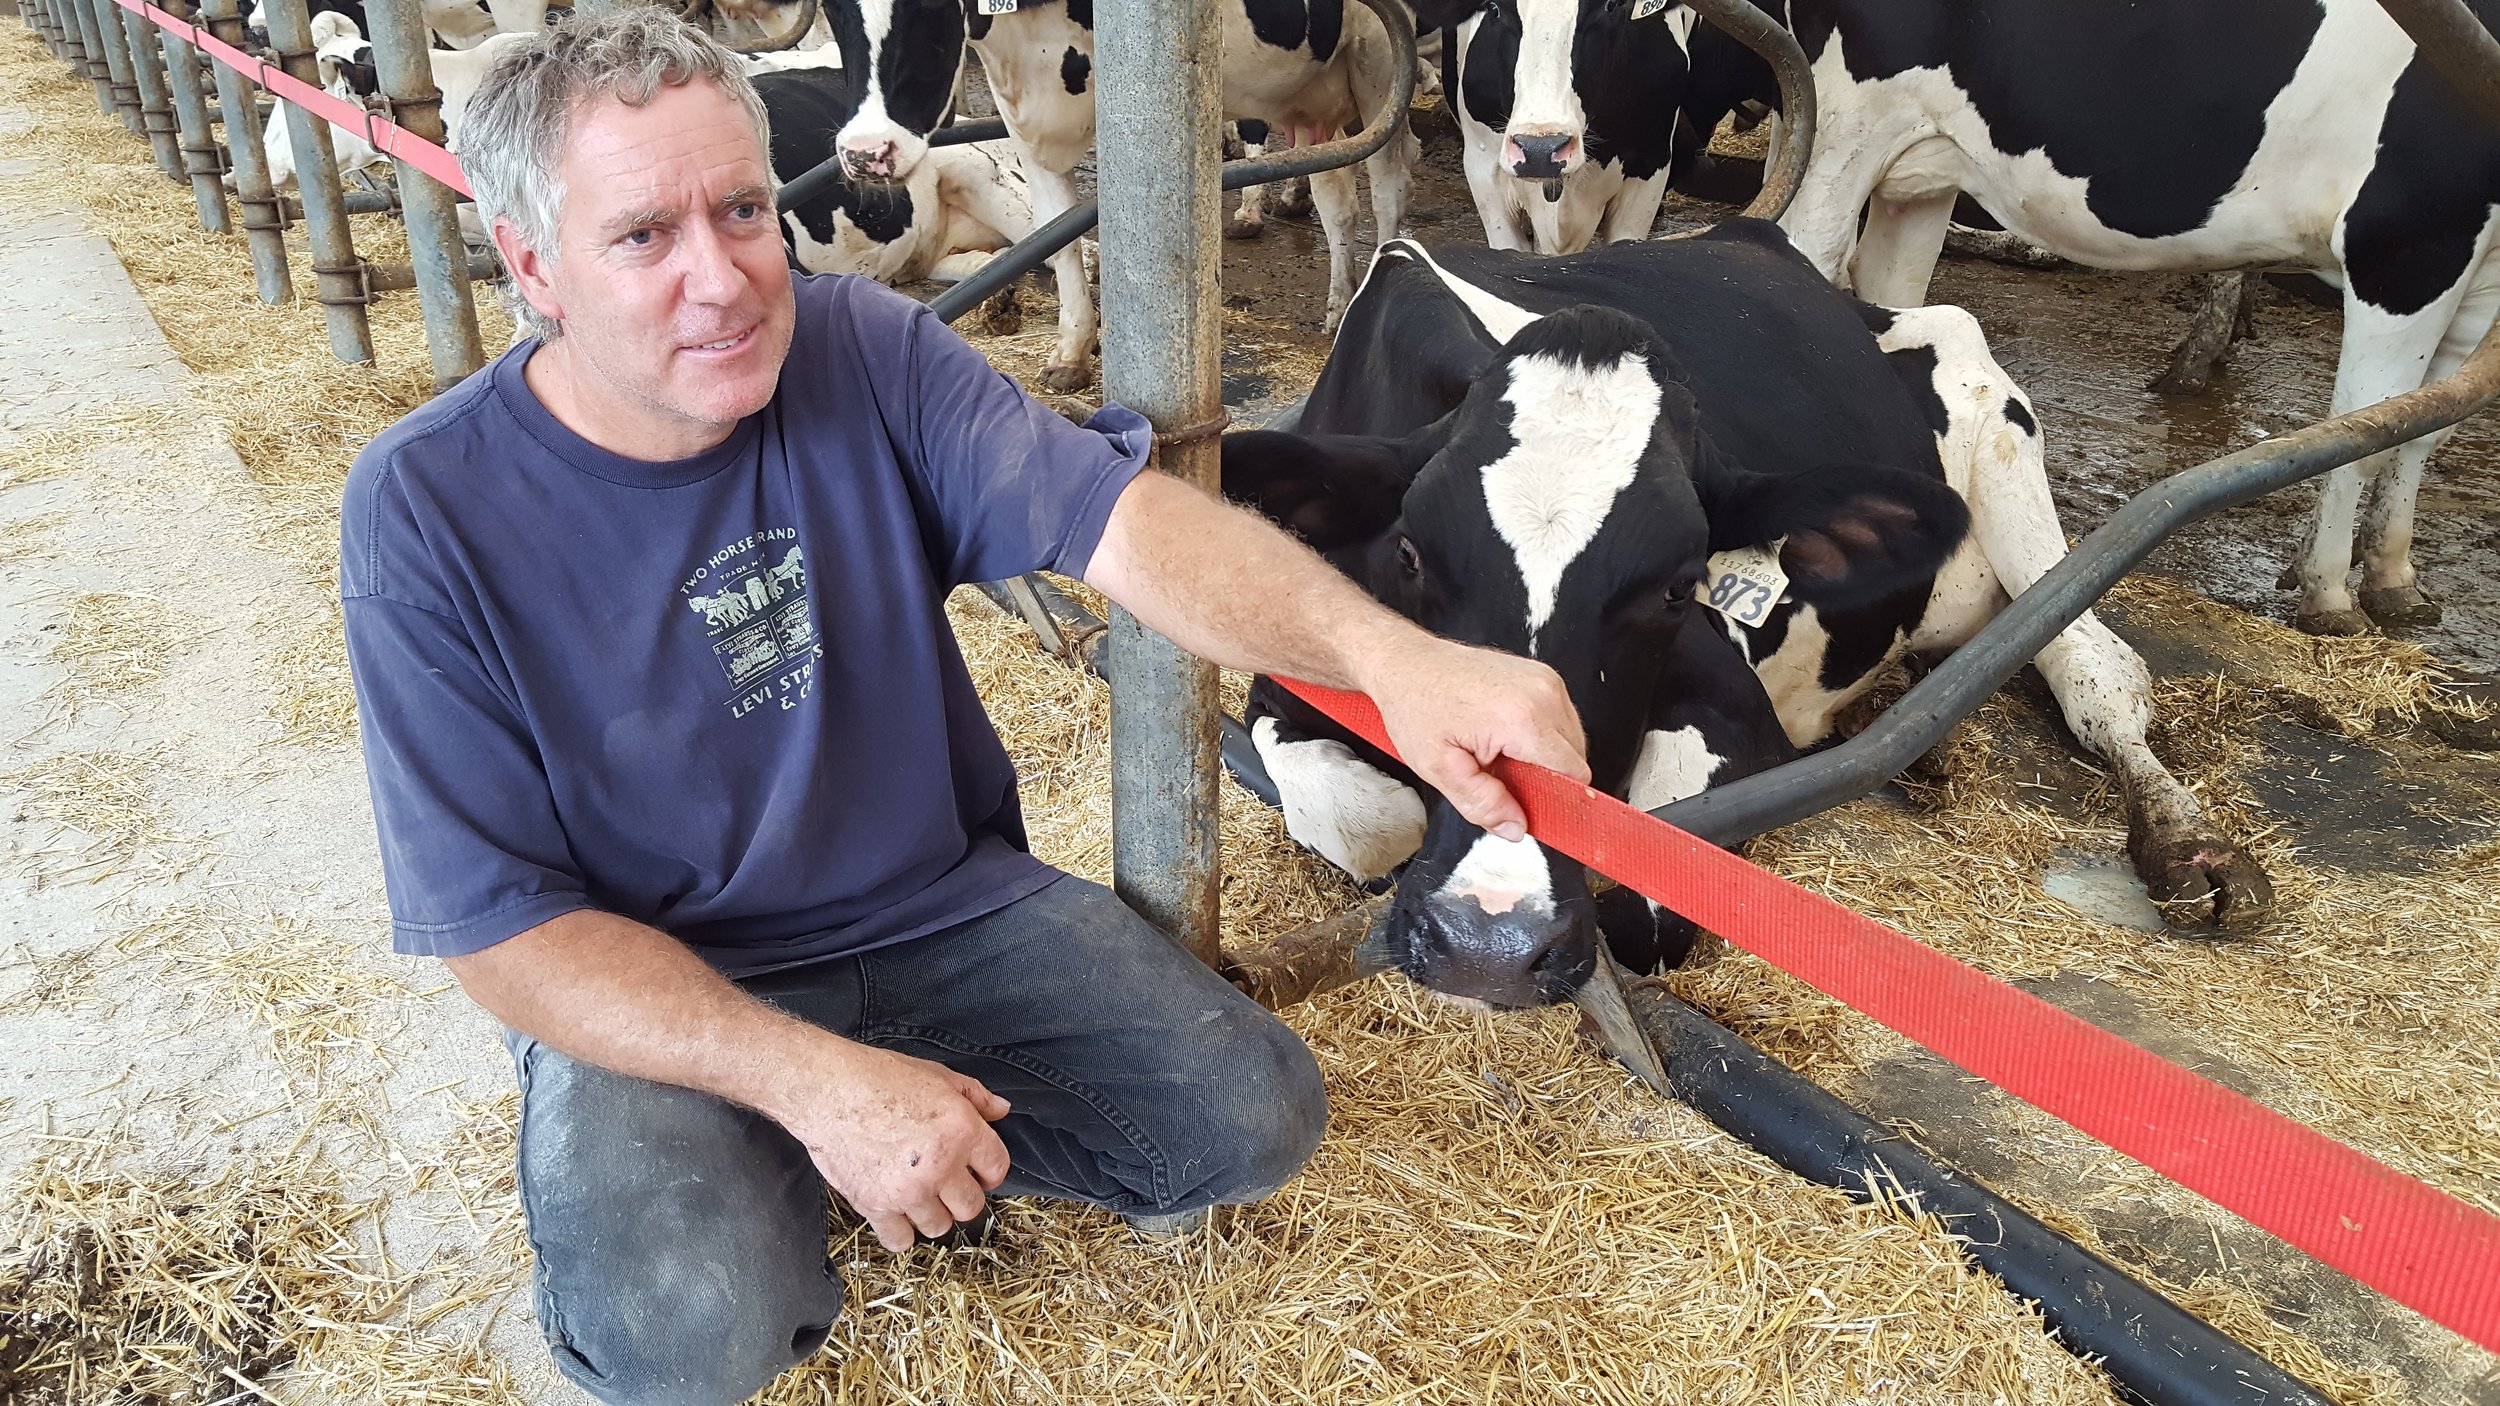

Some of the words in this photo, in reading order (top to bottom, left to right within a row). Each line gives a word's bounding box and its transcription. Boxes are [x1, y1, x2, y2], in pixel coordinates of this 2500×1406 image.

[989, 0, 1014, 12] 896
[680, 567, 708, 595] TWO
[708, 536, 755, 569] HORSE
[756, 527, 796, 544] RAND
[720, 565, 748, 581] TRADE
[1720, 557, 1779, 586] 11768603
[1709, 573, 1771, 620] 873
[721, 641, 734, 651] LEVI
[733, 629, 755, 642] STRAUSS
[732, 685, 773, 719] LEVI
[779, 643, 824, 691] STRS
[780, 696, 796, 710] &
